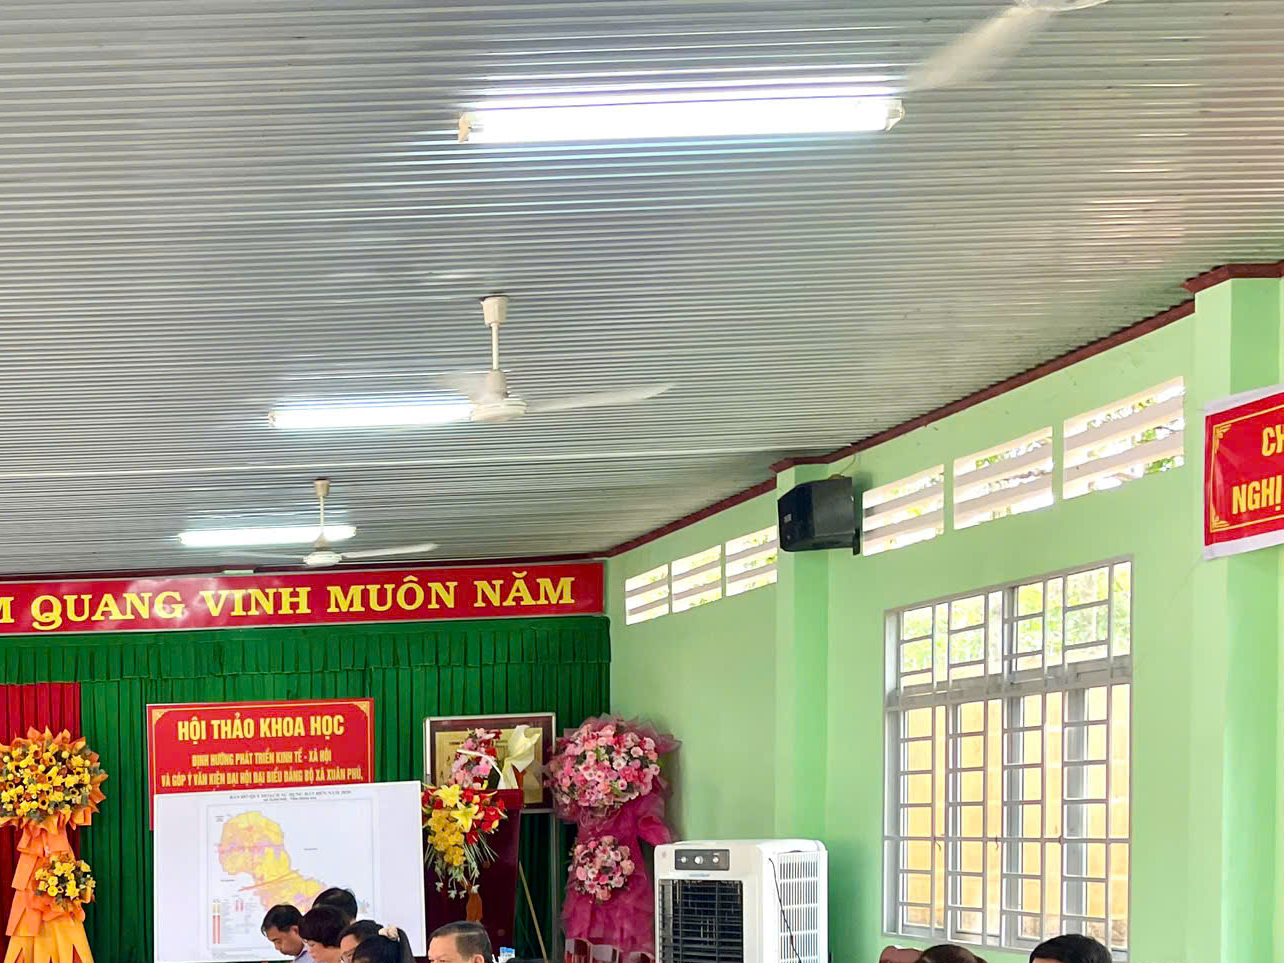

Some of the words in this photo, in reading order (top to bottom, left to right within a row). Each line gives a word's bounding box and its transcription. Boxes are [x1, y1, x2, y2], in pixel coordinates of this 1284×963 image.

[1232, 475, 1283, 515] NGHỊ
[30, 590, 186, 631] QUANG
[199, 586, 312, 617] VINH
[326, 575, 459, 613] MUÔN
[473, 570, 576, 608] NĂM
[177, 716, 207, 745] HỘI
[210, 711, 255, 740] THẢO
[259, 716, 306, 738] KHOA
[309, 714, 345, 740] HỌC
[235, 750, 253, 766] PHÁT
[276, 751, 293, 764] KINH
[293, 747, 303, 763] TẾ
[209, 770, 225, 788] KIỆN
